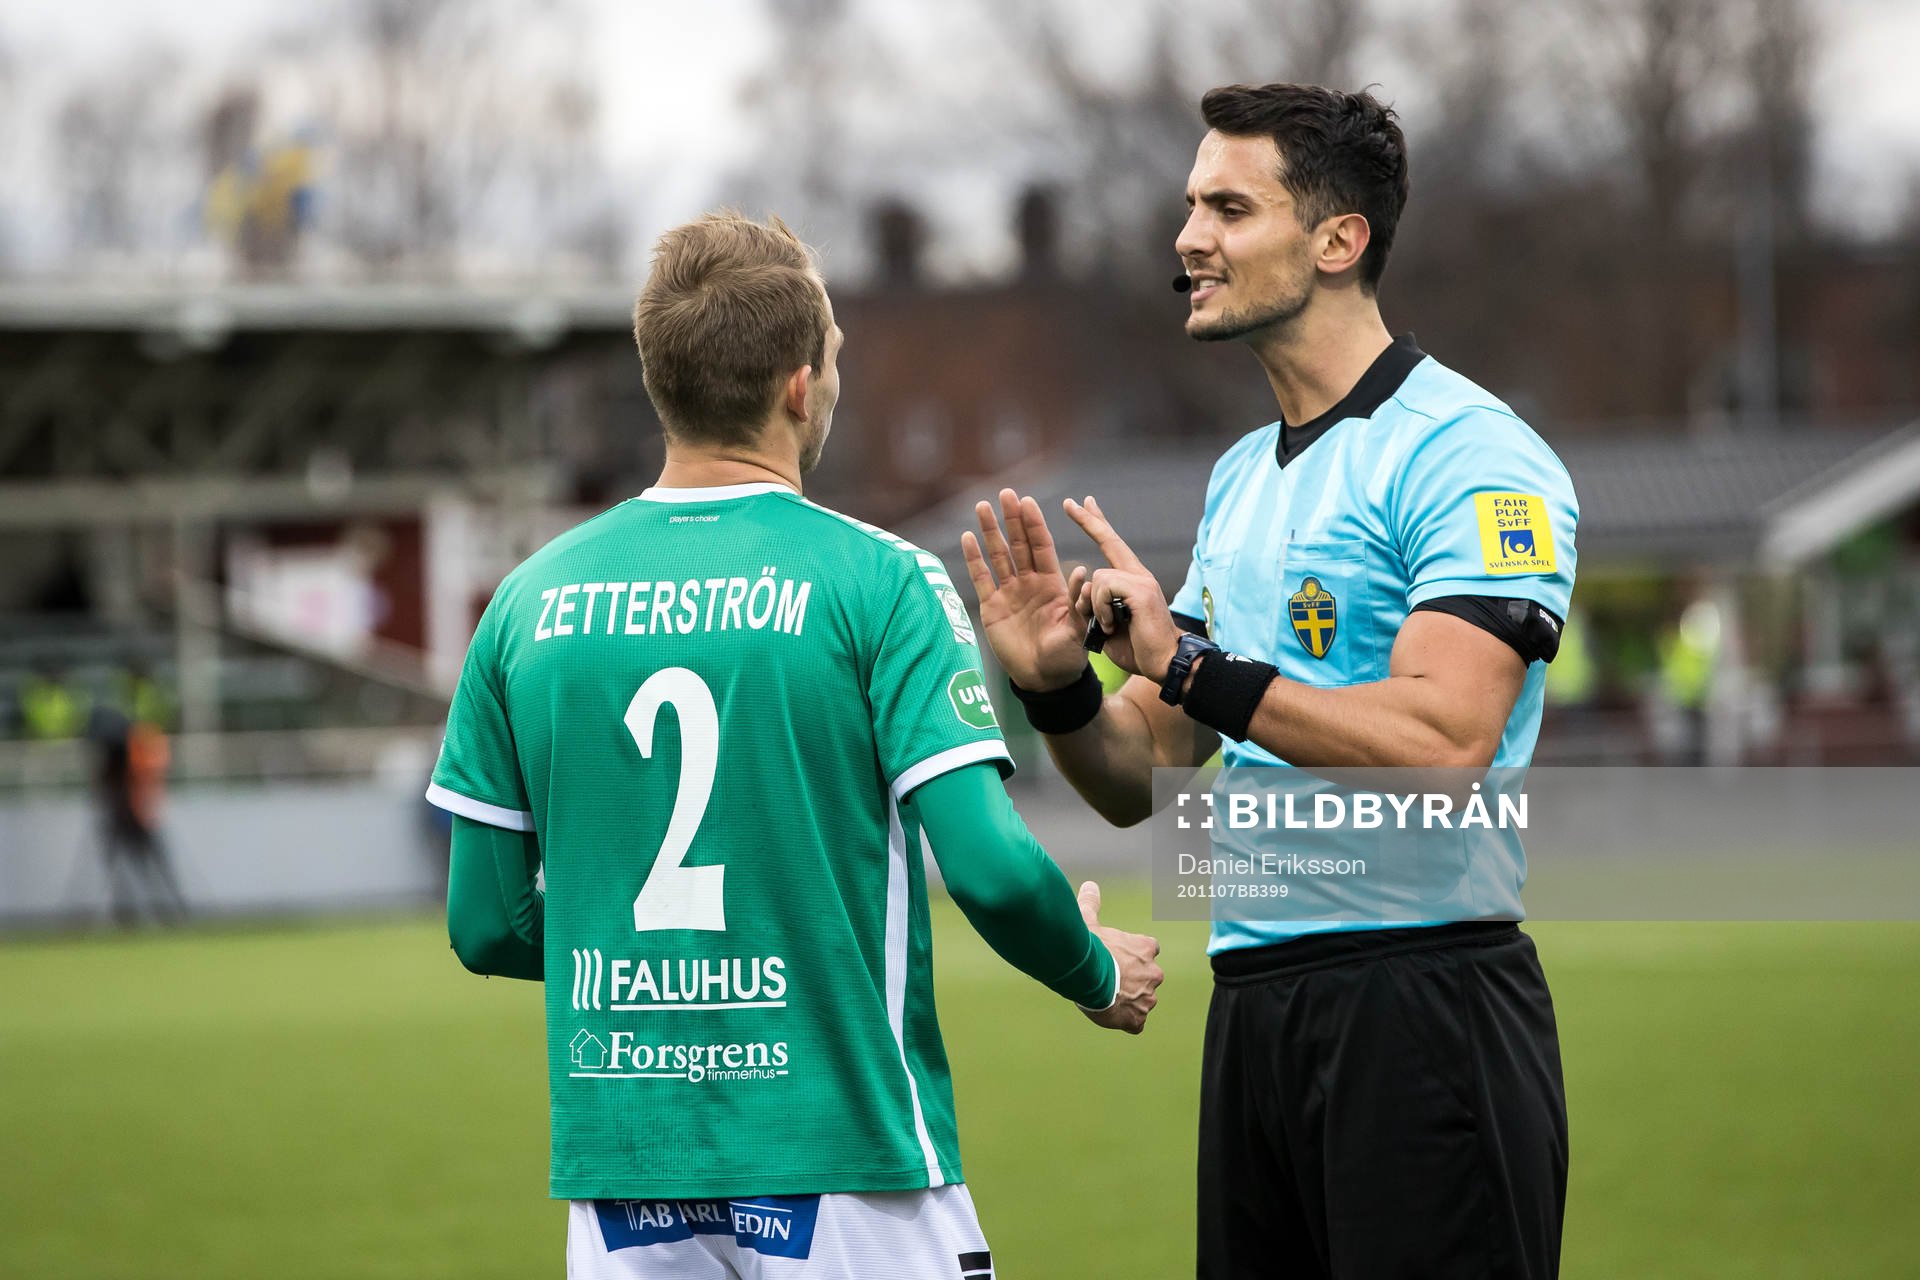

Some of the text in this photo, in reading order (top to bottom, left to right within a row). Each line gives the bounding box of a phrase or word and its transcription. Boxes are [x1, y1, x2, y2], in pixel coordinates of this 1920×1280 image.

[1494, 498, 1527, 507] FAIR
[1495, 508, 1529, 517] PLAY
[1497, 518, 1531, 528] SvFF
[1489, 559, 1552, 568] SVENSKA SPEL
[534, 566, 812, 642] ZETTERSTRÖM
[623, 666, 726, 932] 2
[610, 956, 787, 1001] FALUHUS
[606, 1031, 789, 1083] Forsgrens
[707, 1068, 775, 1081] timmerhus
[639, 1203, 674, 1230] AB
